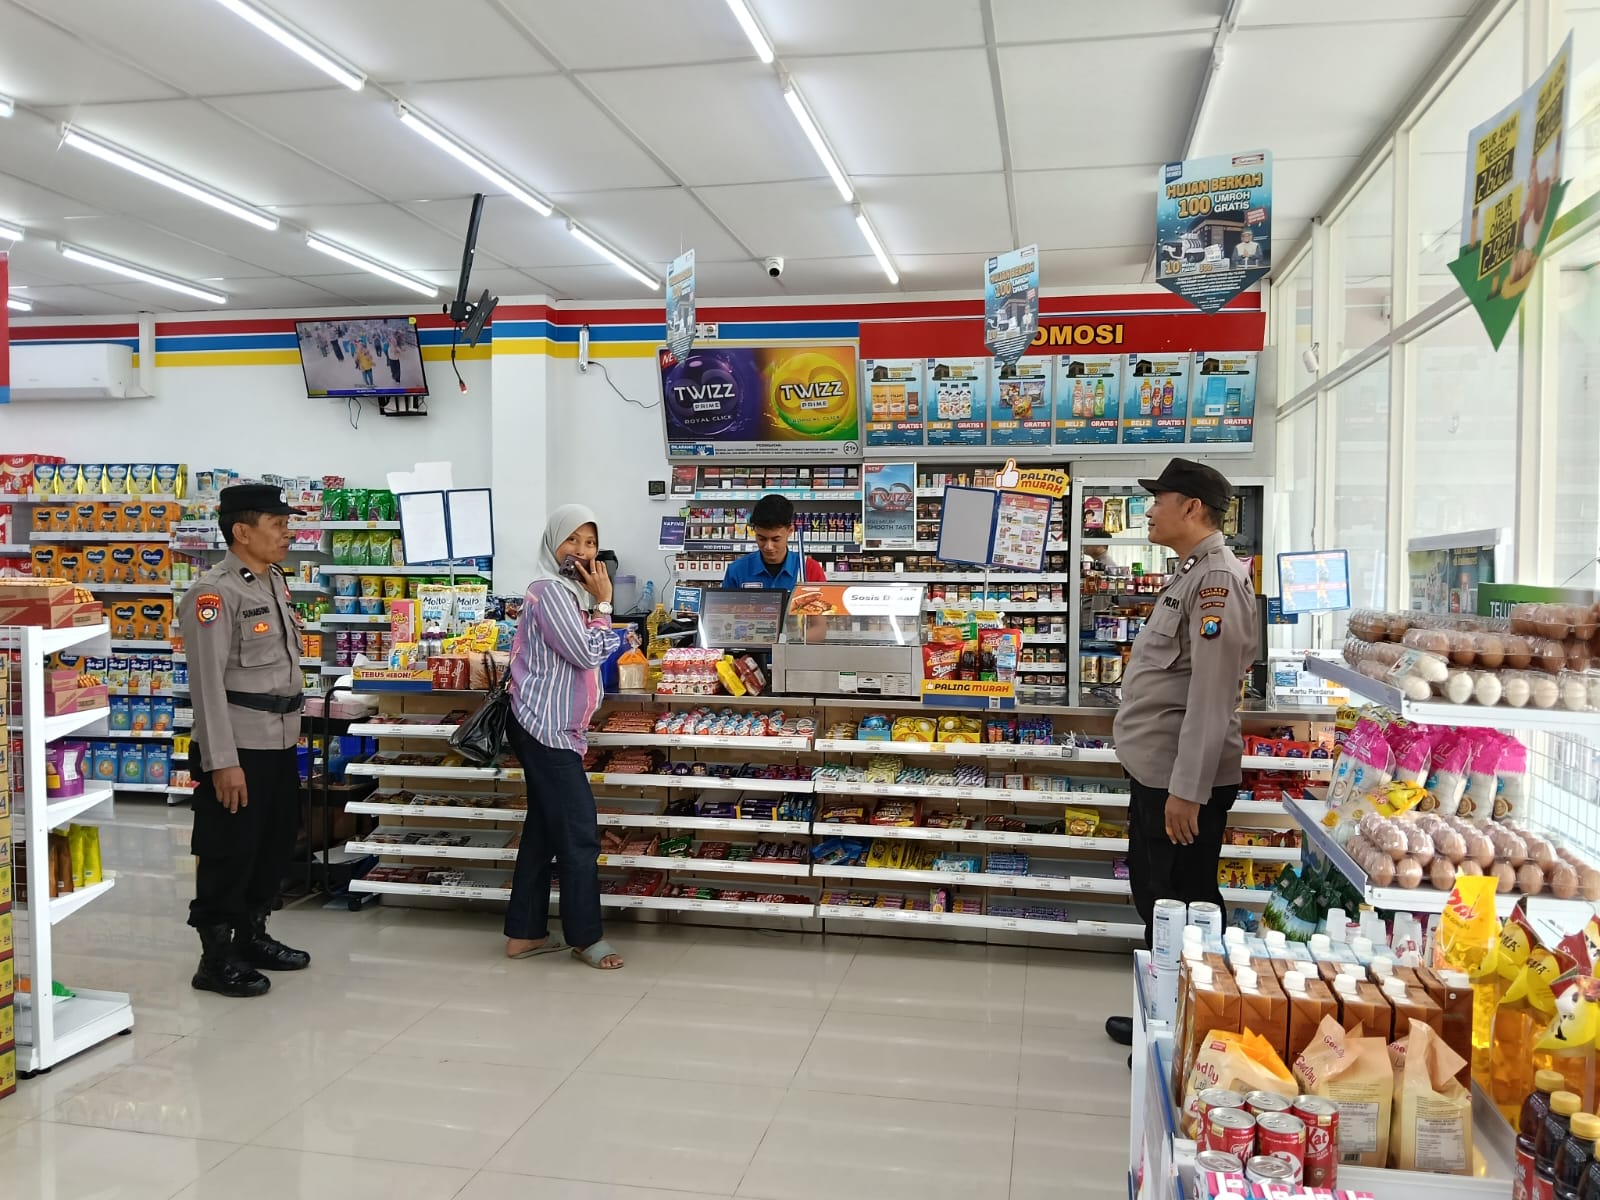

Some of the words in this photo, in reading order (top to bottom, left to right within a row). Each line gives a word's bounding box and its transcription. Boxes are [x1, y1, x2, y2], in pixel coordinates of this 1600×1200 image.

[1166, 179, 1210, 199] HUJAN
[1210, 173, 1263, 194] BERKAH
[1178, 195, 1213, 219] 100
[1214, 191, 1250, 204] UMROH
[1214, 201, 1250, 213] GRATIS
[1031, 325, 1124, 346] OMOSI
[662, 352, 674, 365] NE
[674, 383, 735, 401] TWIZZ
[781, 381, 844, 400] TWIZZ
[694, 402, 721, 410] PRIME
[685, 416, 710, 425] ROYAL
[712, 414, 733, 422] CLICK
[1020, 472, 1065, 485] PALING
[1020, 480, 1063, 494] MURAH
[872, 491, 913, 502] TWIZZ
[850, 594, 880, 602] Sosis
[1163, 595, 1180, 609] POLRI
[360, 671, 385, 679] TEBUS
[934, 683, 971, 692] PALING
[971, 685, 1010, 693] MURAH
[1306, 1125, 1328, 1153] Kat
